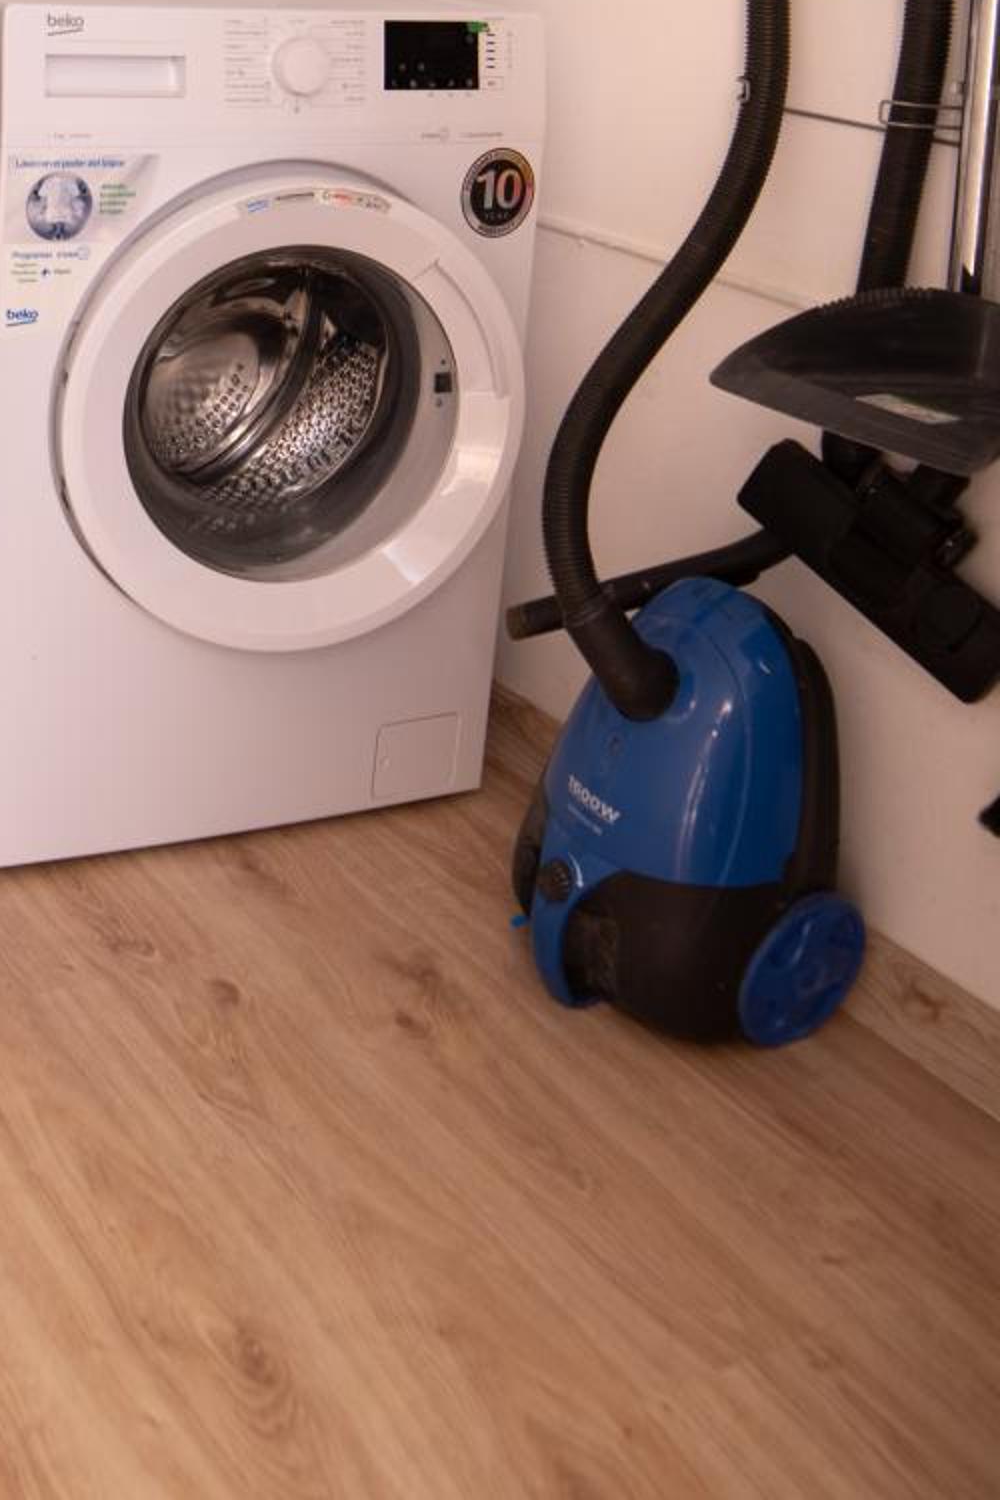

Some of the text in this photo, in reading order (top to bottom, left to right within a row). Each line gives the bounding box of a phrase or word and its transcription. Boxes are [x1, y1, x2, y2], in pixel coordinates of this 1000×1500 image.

[47, 12, 84, 31] beko
[476, 169, 523, 210] 10
[6, 309, 39, 322] beko
